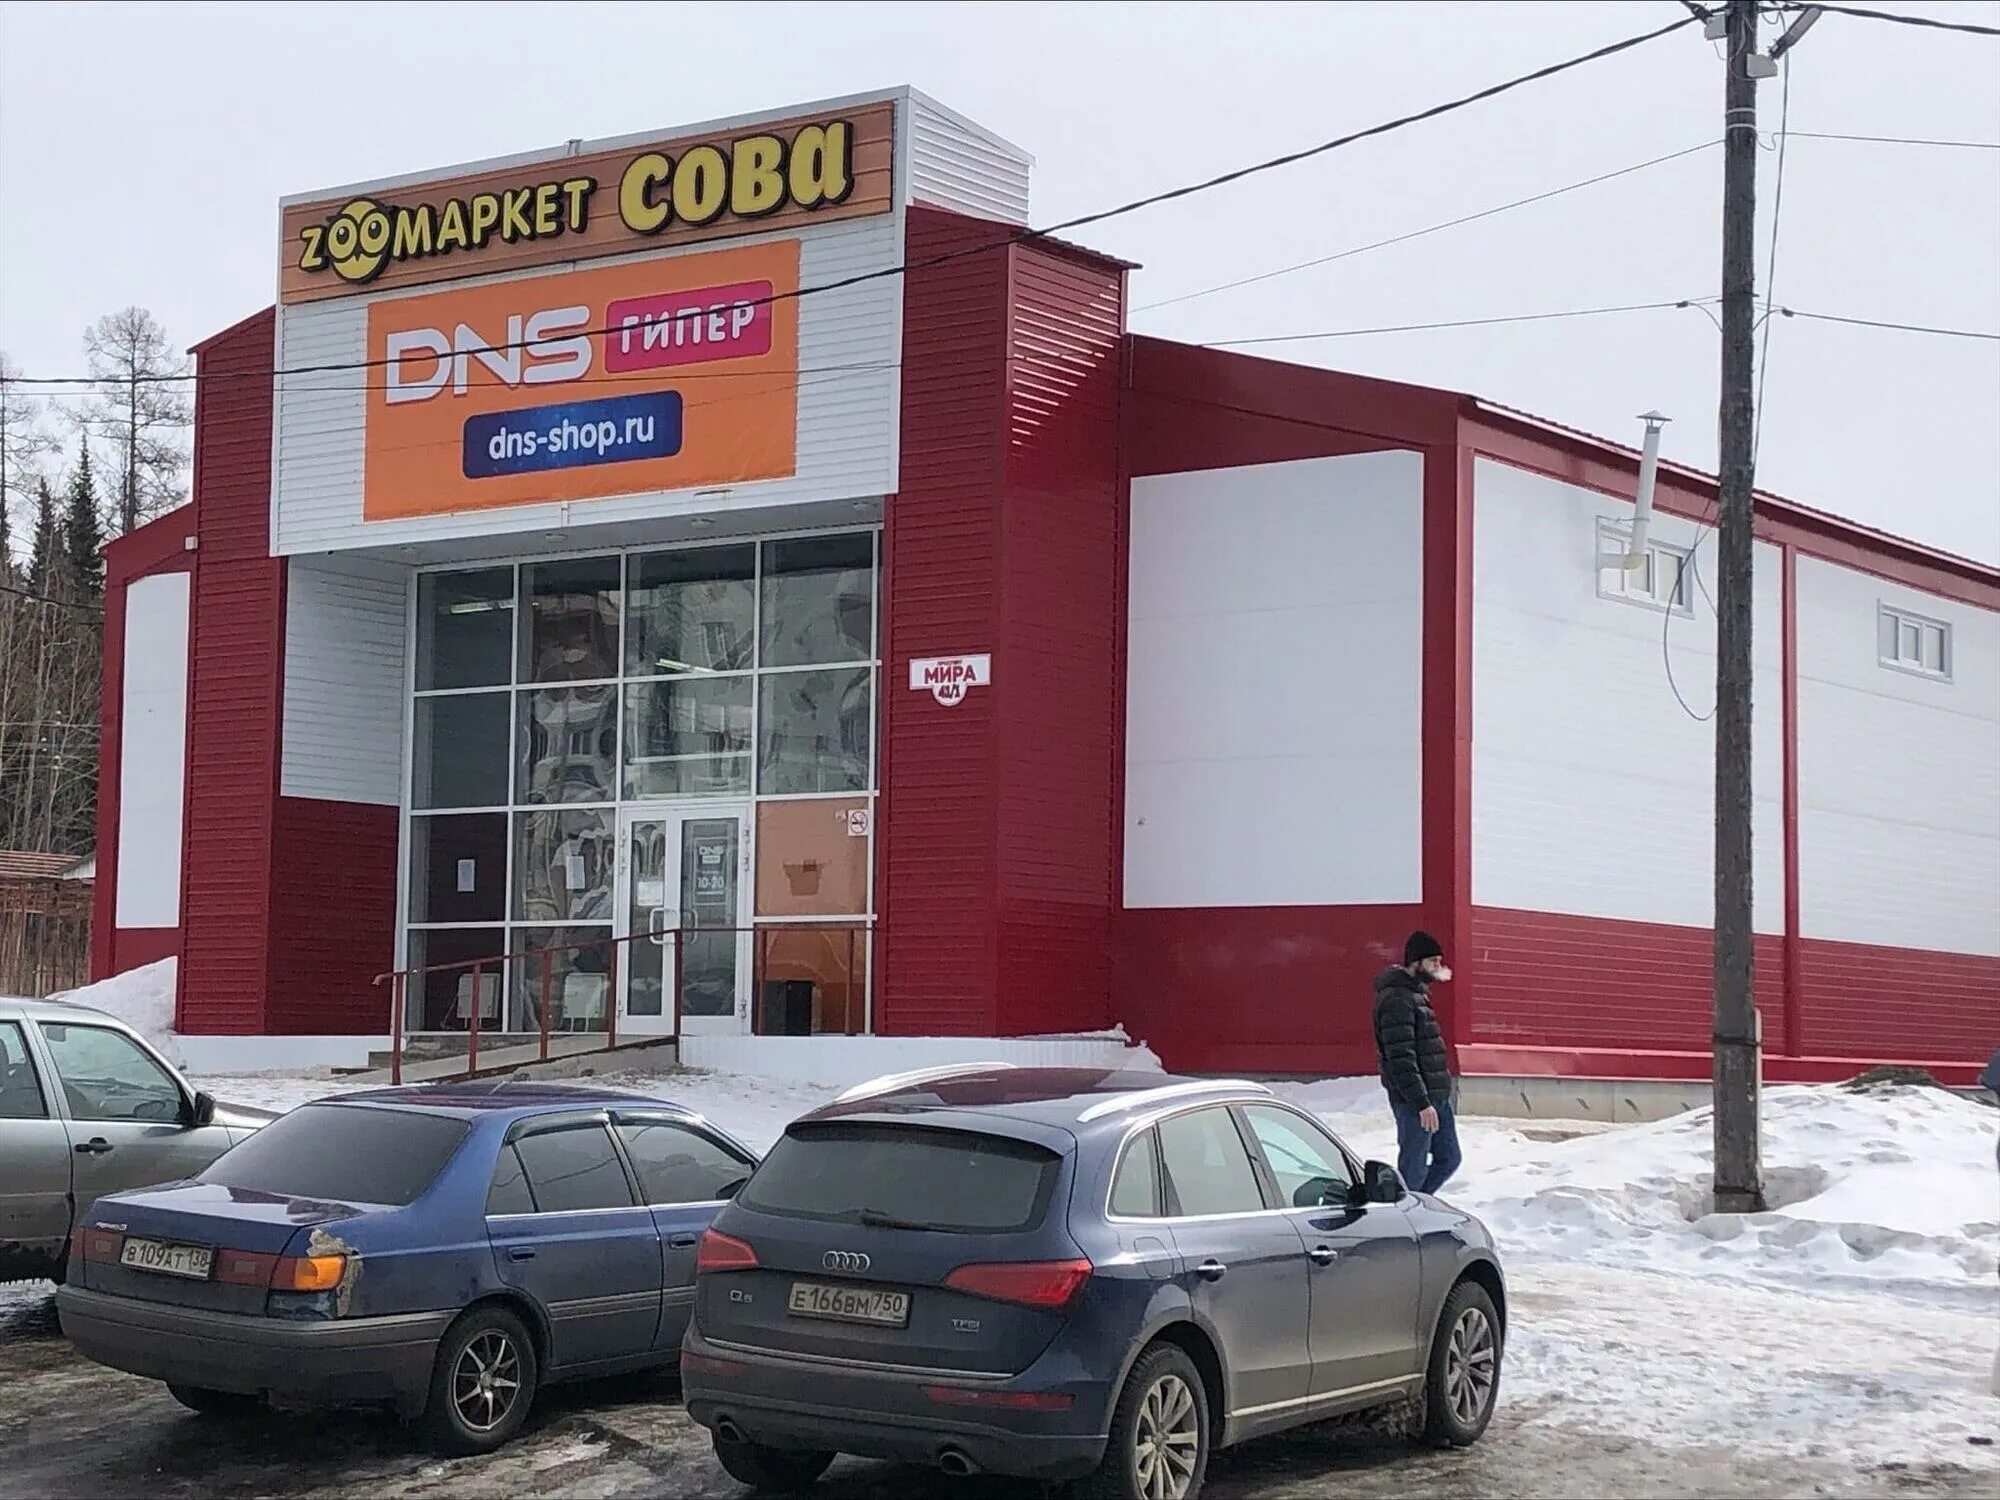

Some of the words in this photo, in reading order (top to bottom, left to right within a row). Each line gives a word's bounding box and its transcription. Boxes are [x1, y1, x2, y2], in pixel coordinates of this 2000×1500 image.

[620, 300, 756, 355] ГИПЕР
[386, 305, 593, 406] DNS
[488, 414, 655, 461] dns-shop.ru
[924, 664, 977, 685] МИРА
